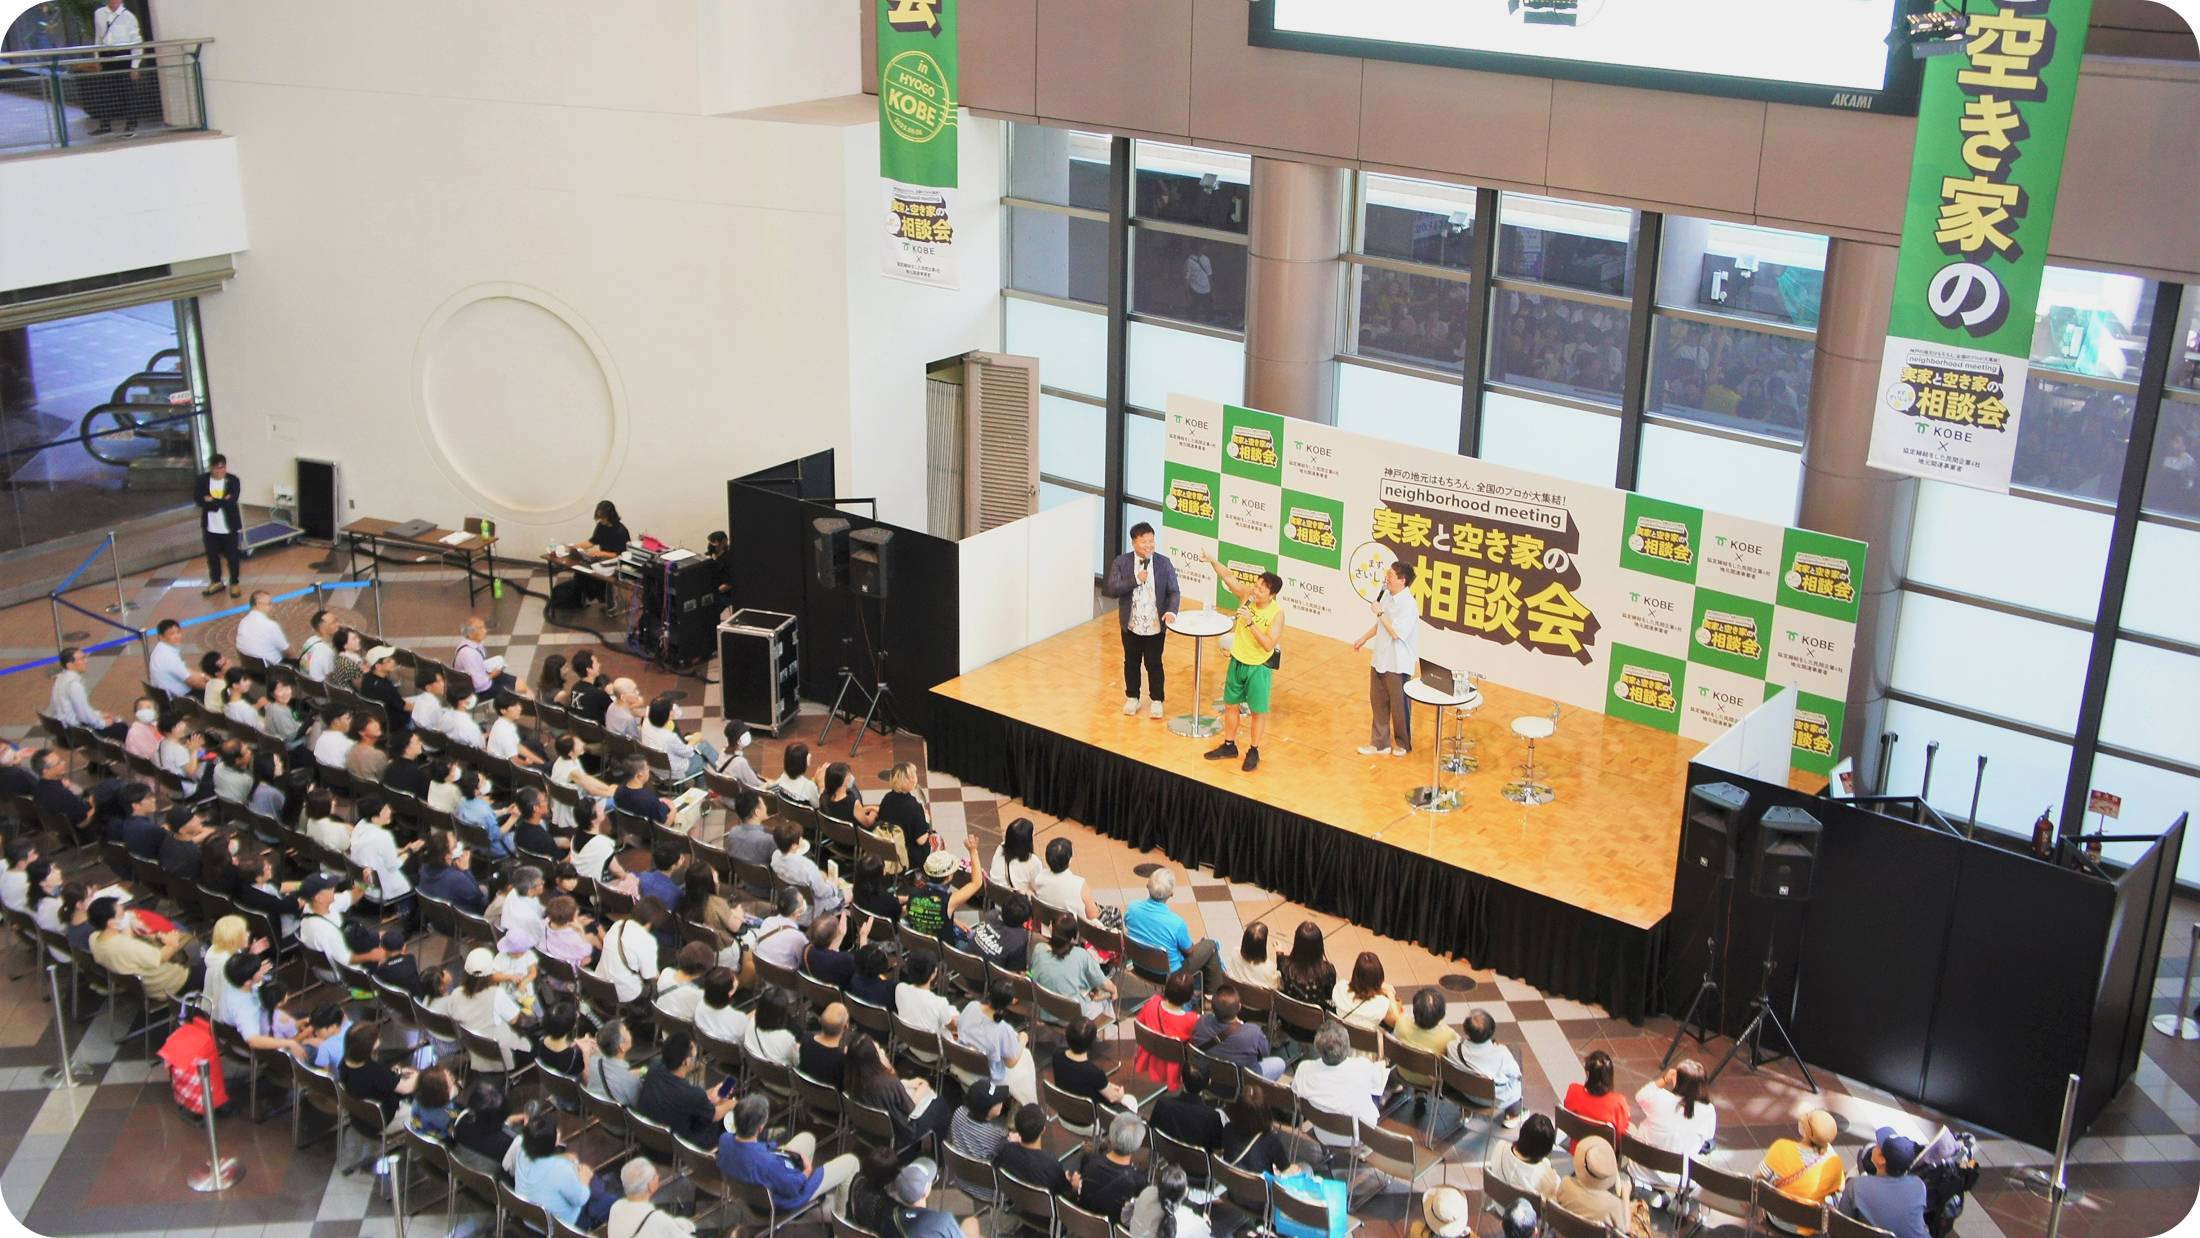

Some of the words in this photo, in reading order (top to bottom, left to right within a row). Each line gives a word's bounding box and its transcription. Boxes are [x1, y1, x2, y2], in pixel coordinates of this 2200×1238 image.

[917, 60, 928, 74] in
[900, 72, 935, 98] HYOGO
[889, 88, 937, 126] KOBE
[1832, 93, 1873, 109] AKAMI
[1928, 0, 2048, 325] 空き家の
[902, 216, 951, 242] 相談会
[912, 245, 935, 255] KOBE
[1965, 362, 1998, 373] meeting
[1902, 367, 1999, 393] 実家と空き家の
[1916, 386, 2008, 428] 相談会
[1185, 418, 1208, 430] KOBE
[1934, 427, 1973, 443] KOBE
[1239, 446, 1276, 464] 相談会
[1306, 444, 1332, 457] KOBE
[1178, 500, 1213, 518] 相談会
[1242, 499, 1266, 511] KOBE
[1385, 485, 1490, 513] neighborhood
[1495, 504, 1561, 528] meeting
[1297, 527, 1336, 548] 相談会
[1372, 507, 1570, 573] 実家と空き家の
[1181, 548, 1200, 561] KOB
[1644, 540, 1691, 562] 相談会
[1730, 540, 1763, 555] KOBE
[1354, 568, 1381, 583] さいし
[1300, 582, 1325, 595] KOBE
[1801, 576, 1853, 600] 相談会
[1411, 554, 1591, 653] 相談会
[1644, 596, 1674, 612] KOBE
[1710, 633, 1760, 656] 相談会
[1802, 635, 1835, 652] KOBE
[571, 691, 584, 710] K
[1630, 688, 1676, 710] 相談会
[1713, 691, 1744, 707] KOBE
